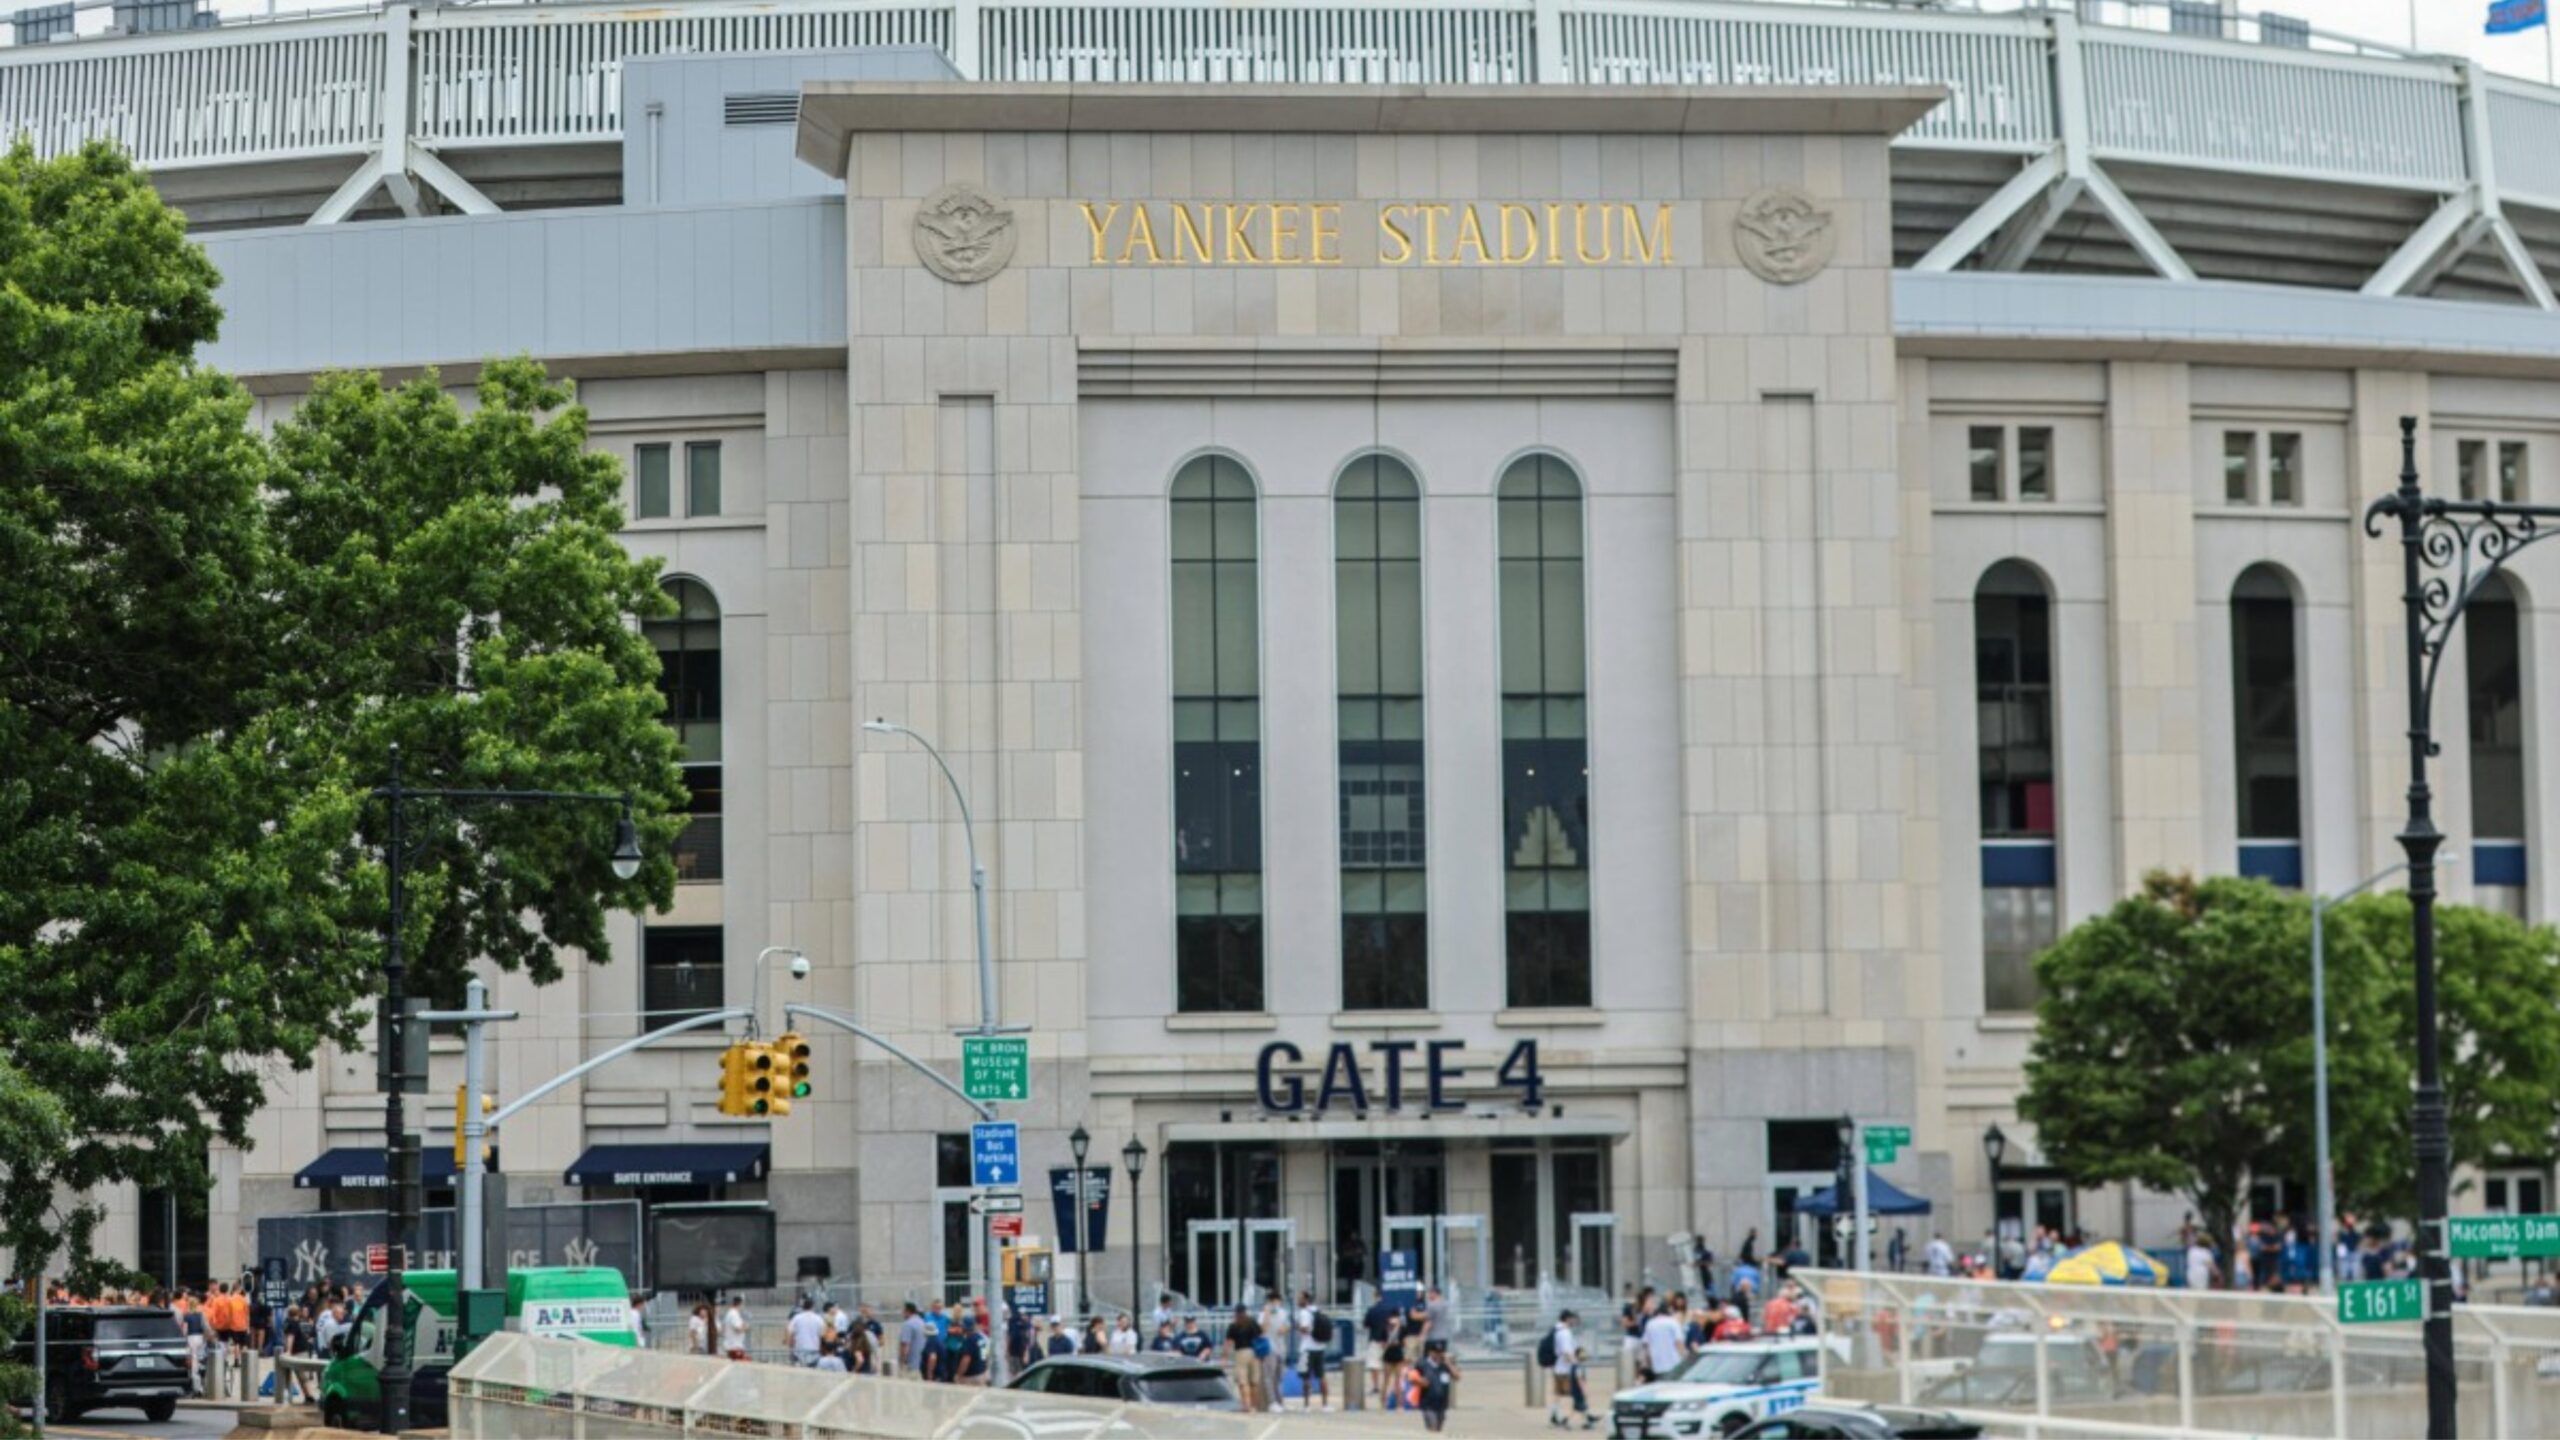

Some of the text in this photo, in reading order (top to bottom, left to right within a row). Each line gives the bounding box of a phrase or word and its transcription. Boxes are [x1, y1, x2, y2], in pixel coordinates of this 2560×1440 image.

[1080, 202, 1675, 264] YANKEE STADIUM
[966, 1043, 984, 1053] THE
[971, 1056, 1019, 1067] MUSEUM
[974, 1069, 1016, 1080] OF THE
[1257, 1038, 1543, 1111] GATE 4
[971, 1085, 1001, 1095] ARTS
[974, 1128, 1014, 1139] Stadium
[985, 1141, 1004, 1151] Bus
[976, 1153, 1014, 1165] Parking
[614, 1171, 692, 1184] SUITE ENTRANCE
[2452, 1219, 2559, 1242] Macombs Dam
[2344, 1289, 2355, 1318] E
[2365, 1288, 2397, 1316] 161
[537, 1307, 576, 1325] A&A
